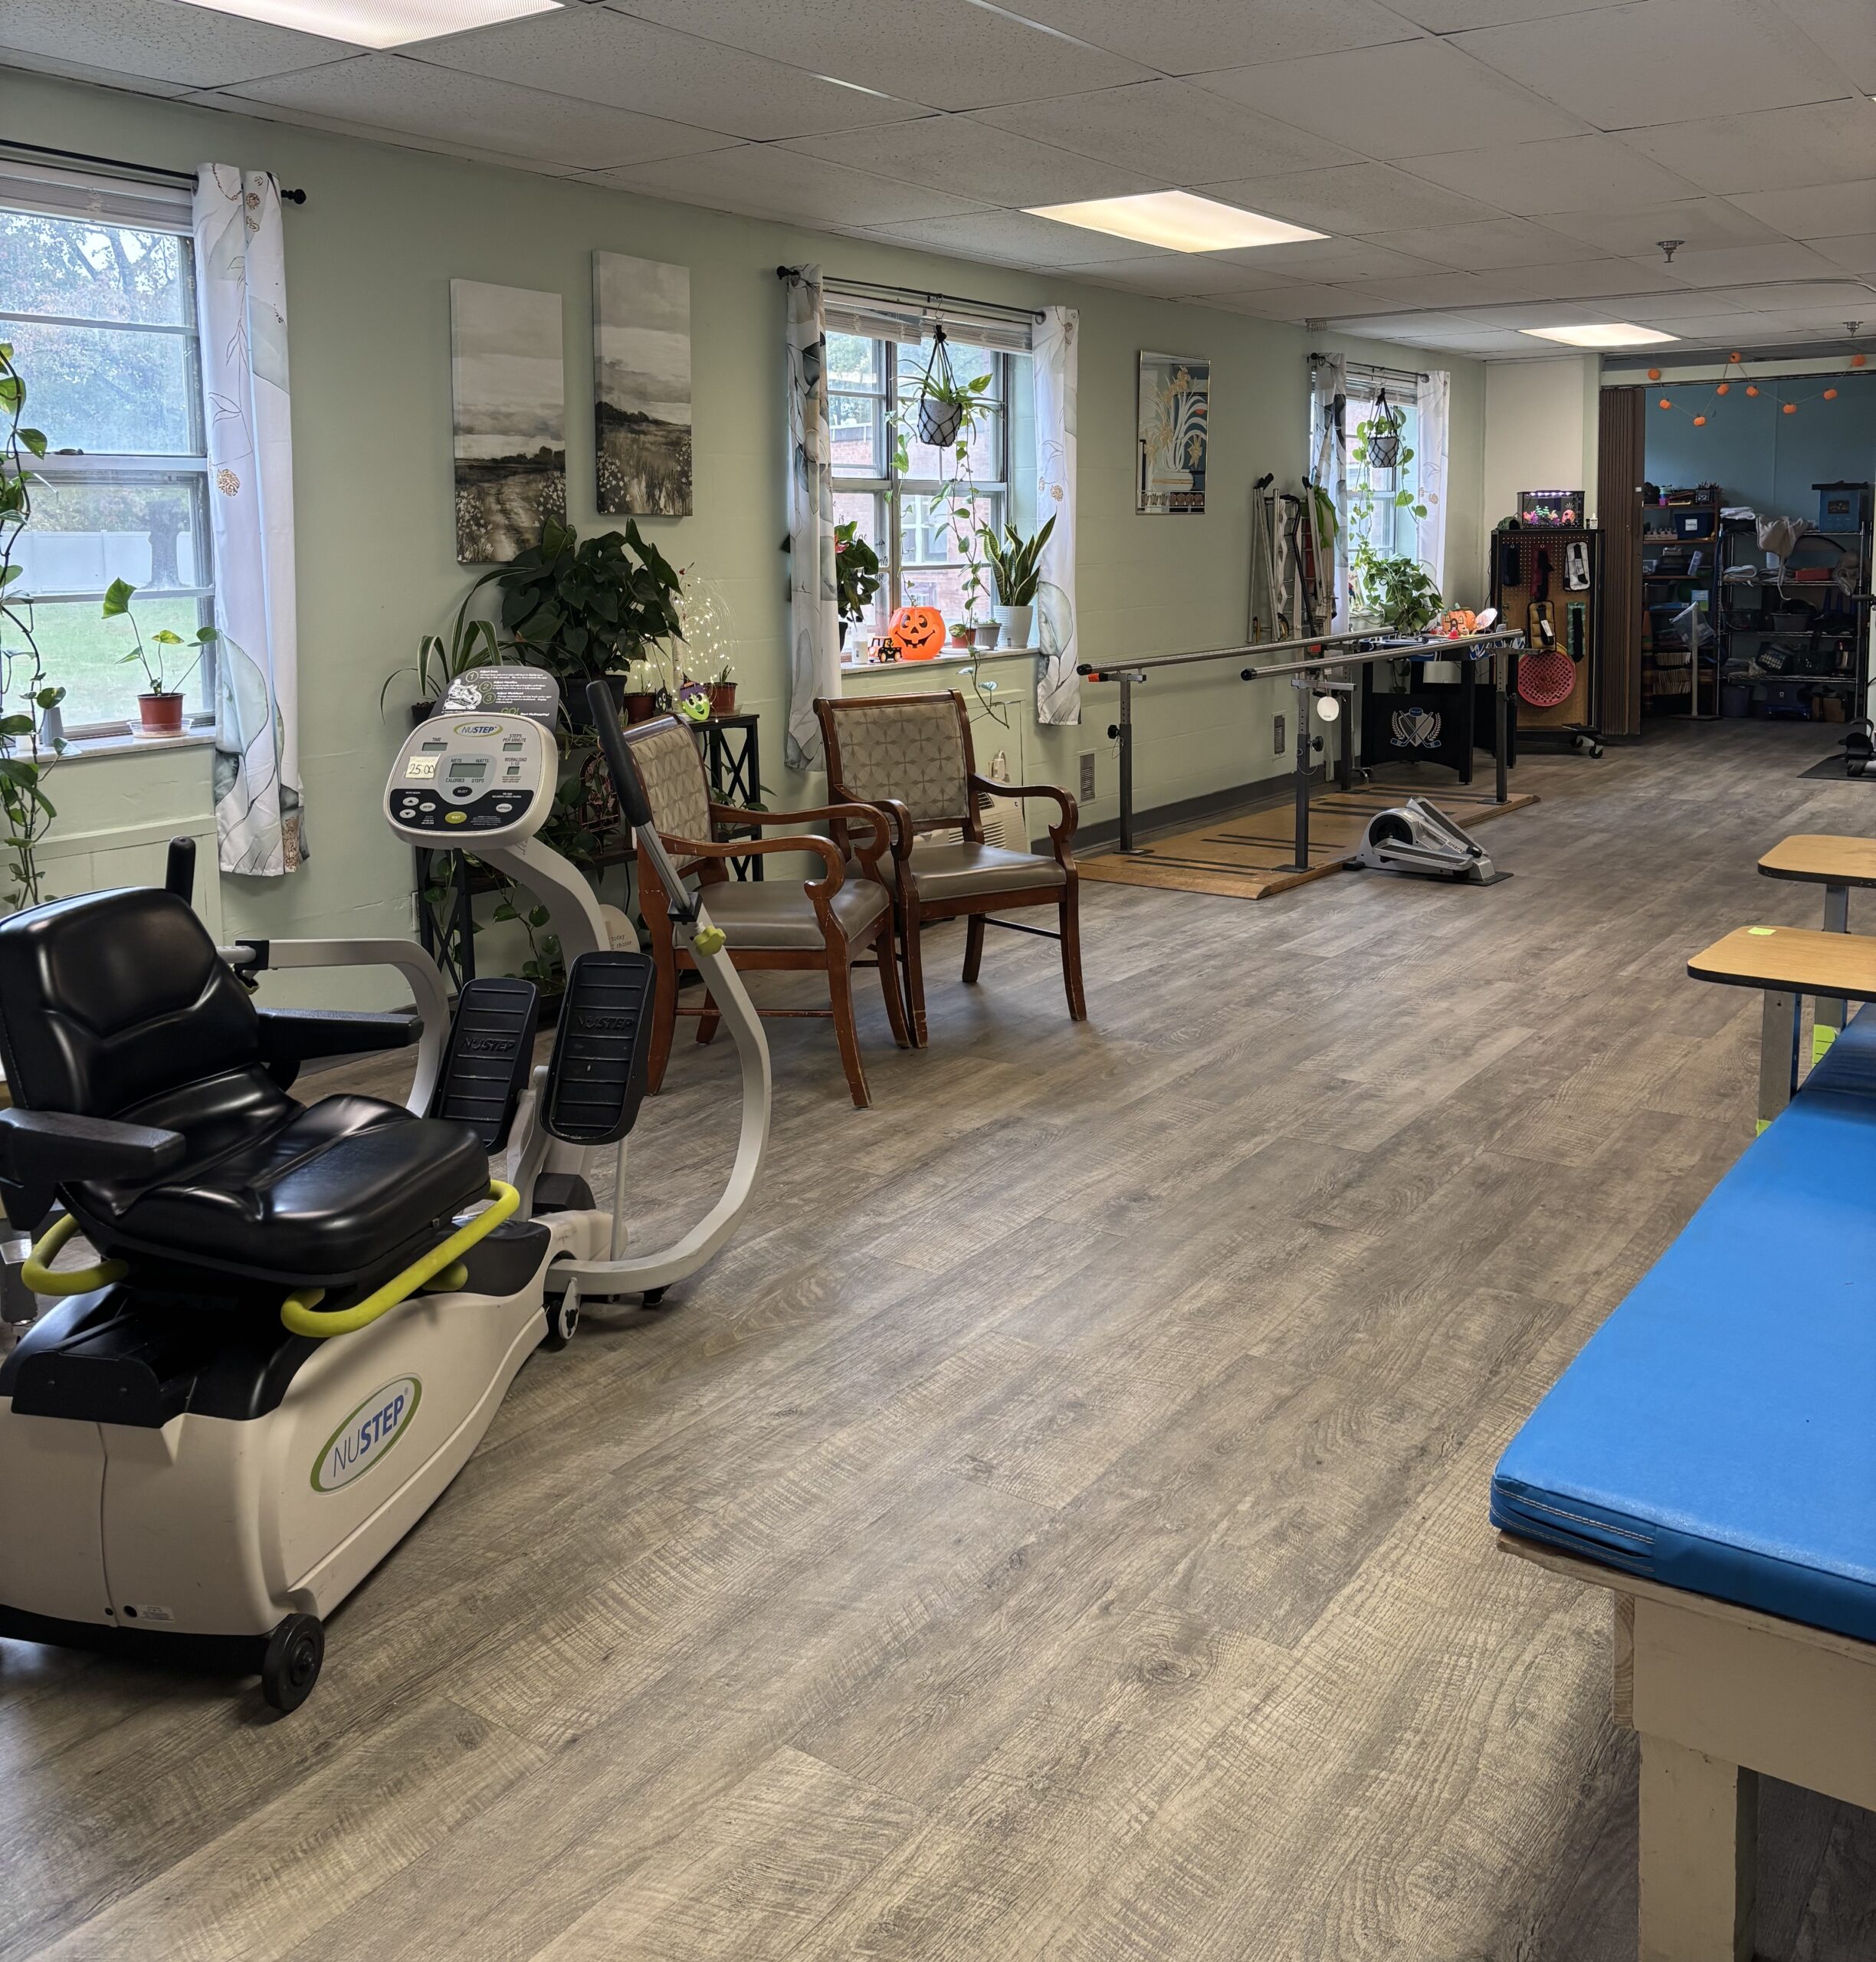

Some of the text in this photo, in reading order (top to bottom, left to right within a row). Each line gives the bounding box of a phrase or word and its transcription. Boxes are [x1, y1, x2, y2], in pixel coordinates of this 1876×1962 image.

[501, 707, 520, 716] GO!
[462, 726, 494, 734] NUSTEP
[578, 1015, 634, 1029] NUSTEP
[461, 1037, 516, 1052] NUSTEP
[333, 1394, 405, 1478] NUSTEP
